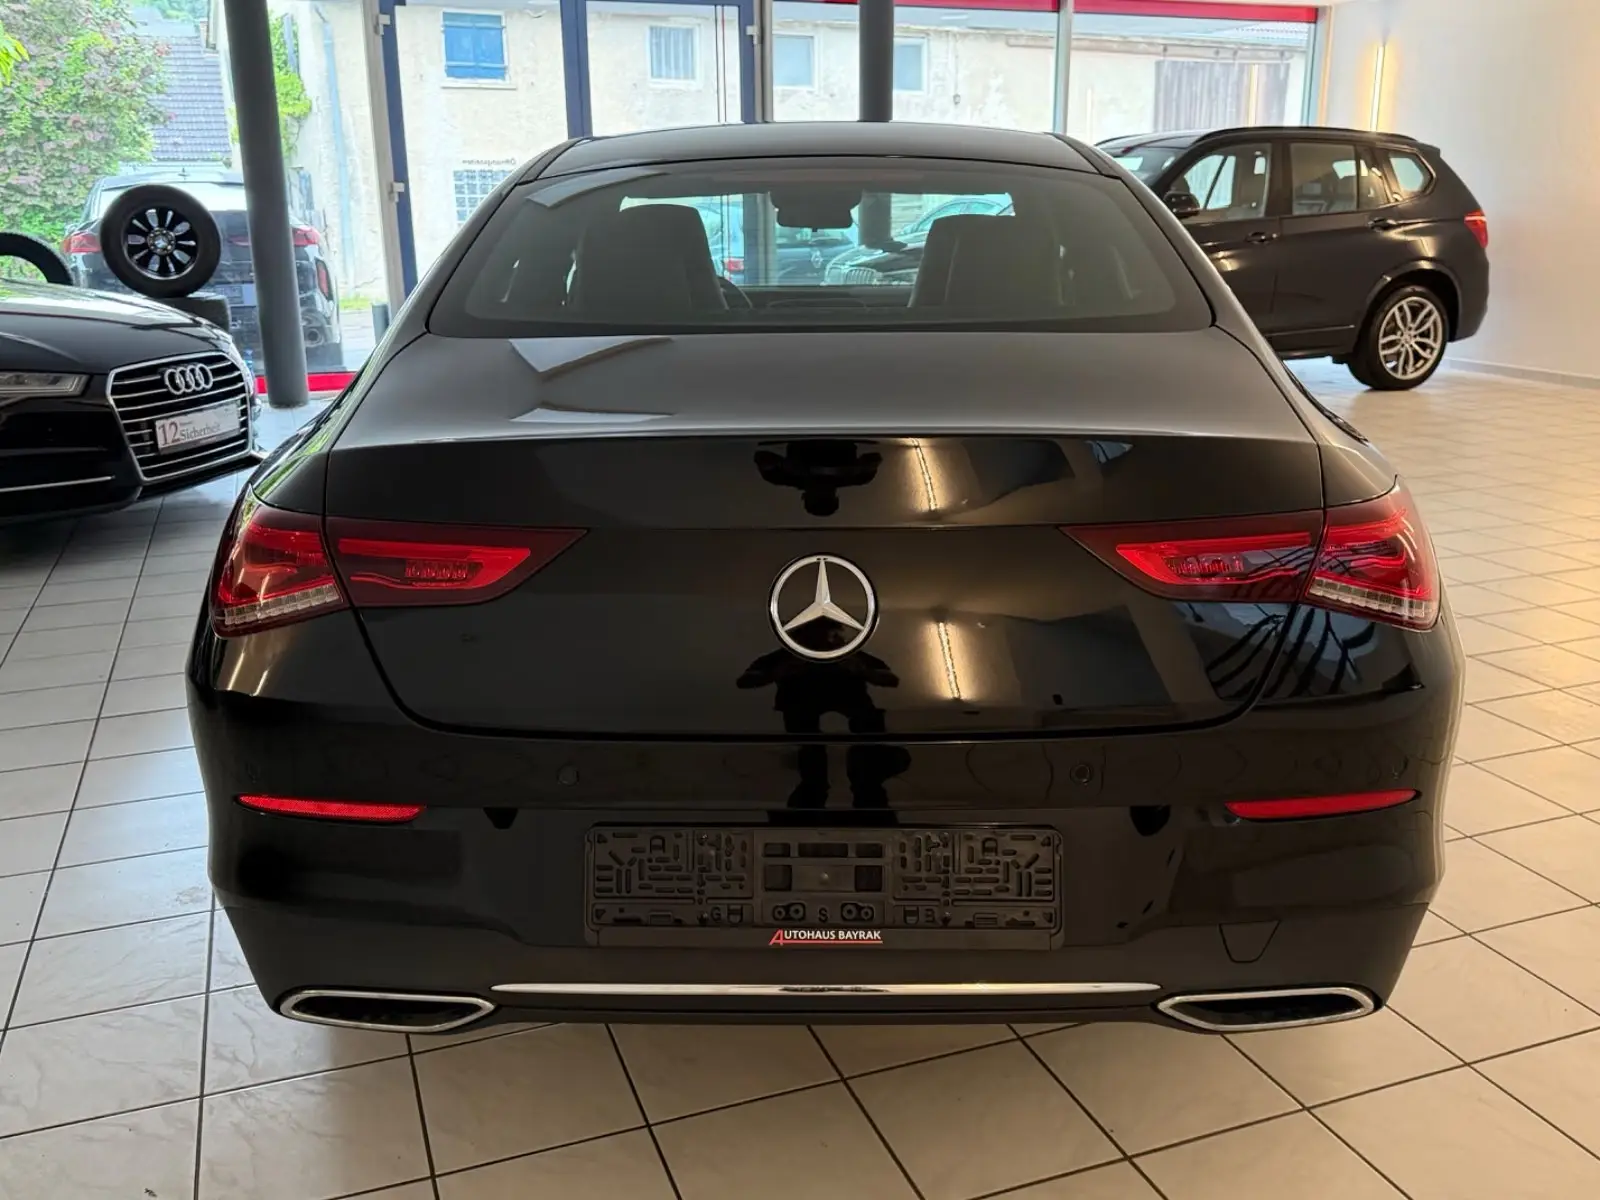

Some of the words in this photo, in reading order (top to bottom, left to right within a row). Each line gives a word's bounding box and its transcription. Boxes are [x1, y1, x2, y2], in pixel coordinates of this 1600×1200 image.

[158, 421, 180, 446] 12
[768, 929, 836, 946] AUTOHAUS
[838, 930, 881, 940] BAYRAK
